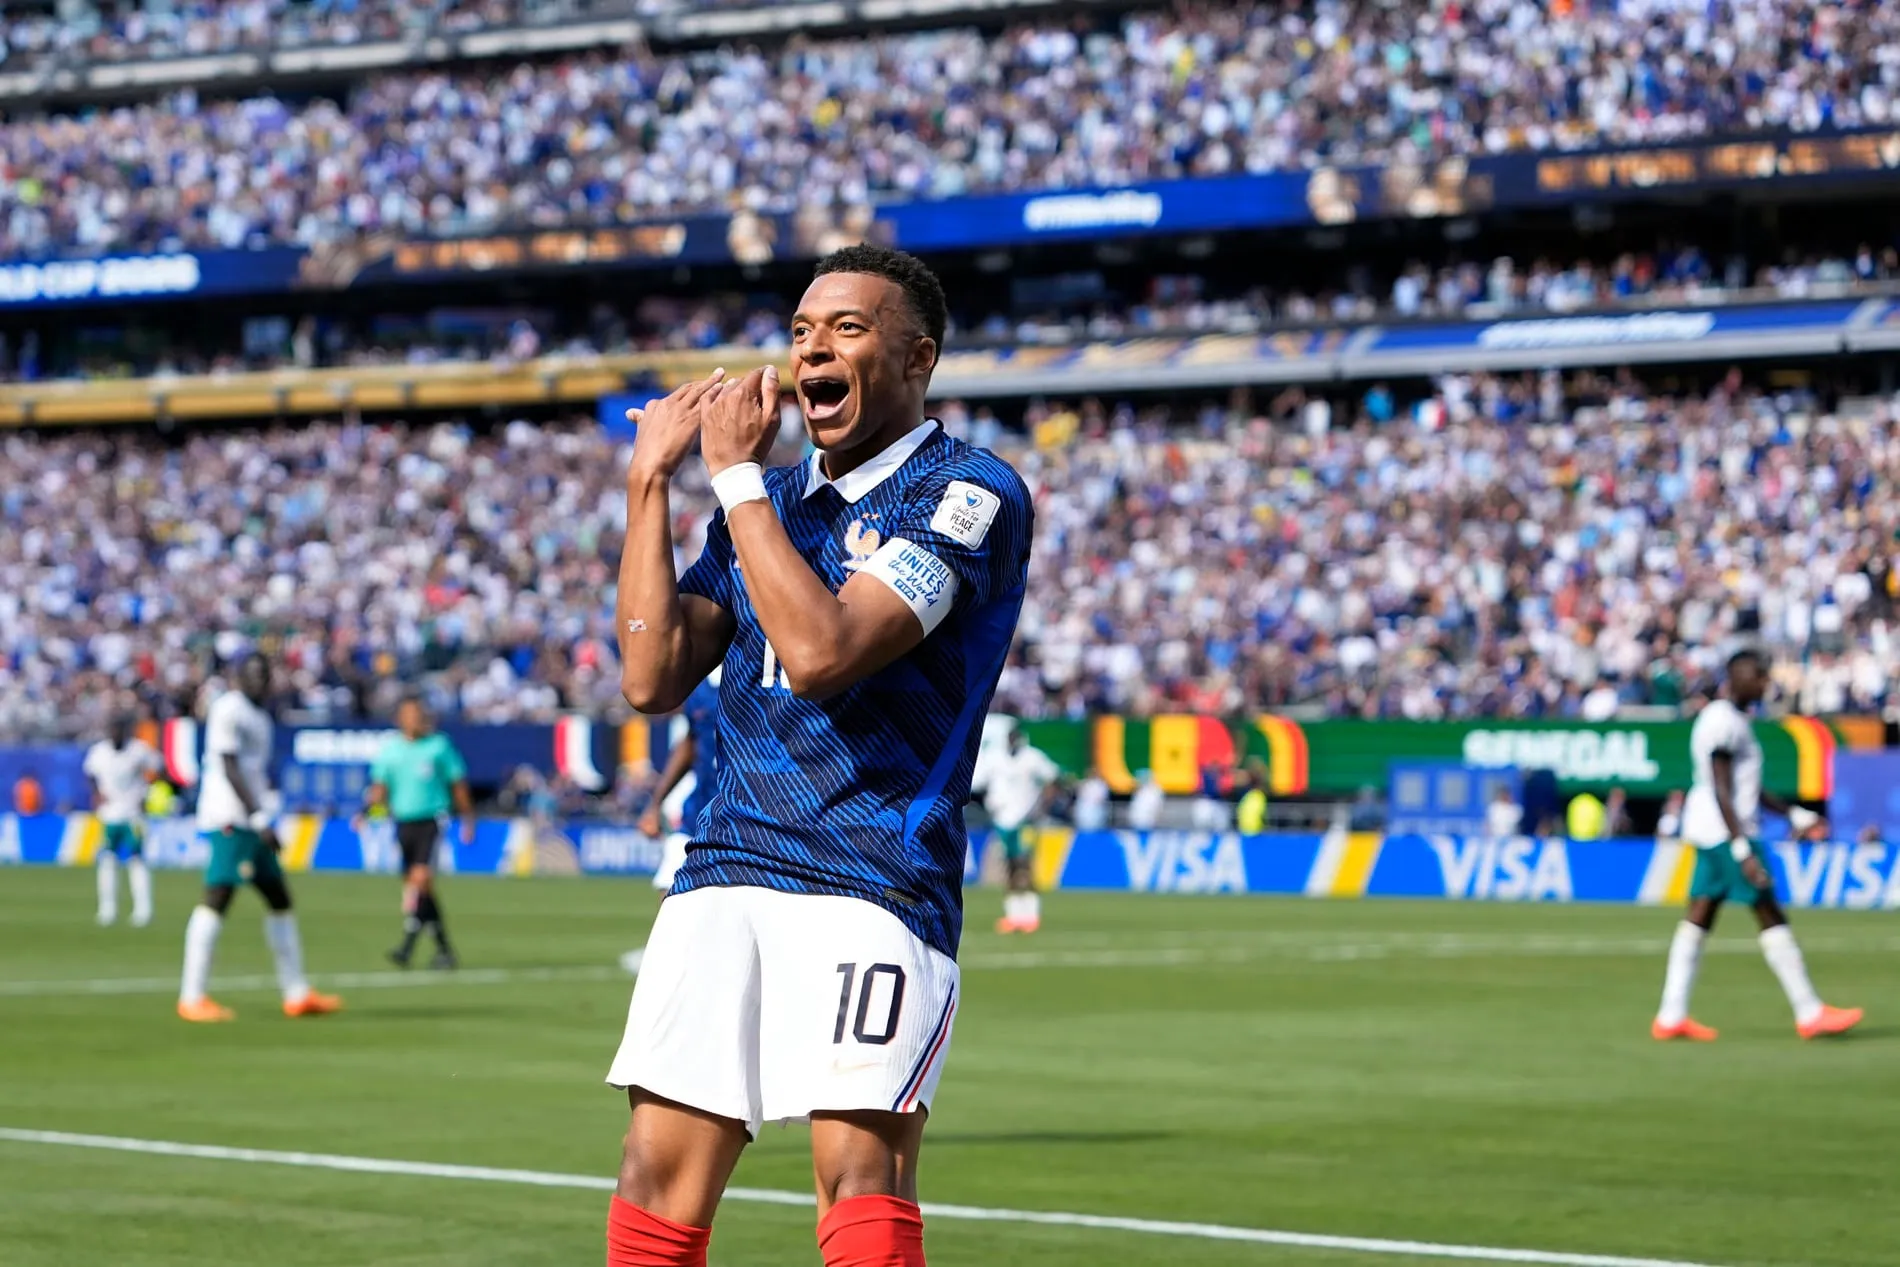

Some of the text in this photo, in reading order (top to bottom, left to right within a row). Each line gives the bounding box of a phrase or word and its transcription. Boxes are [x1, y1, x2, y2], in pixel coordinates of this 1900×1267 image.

[950, 513, 975, 533] PEACE
[888, 559, 938, 608] the World
[898, 549, 944, 595] UNITES
[907, 543, 950, 584] FOOTBALL
[894, 578, 917, 601] FIFA
[1115, 829, 1249, 895] VISA
[1429, 834, 1575, 904] VISA
[833, 962, 906, 1046] 10
